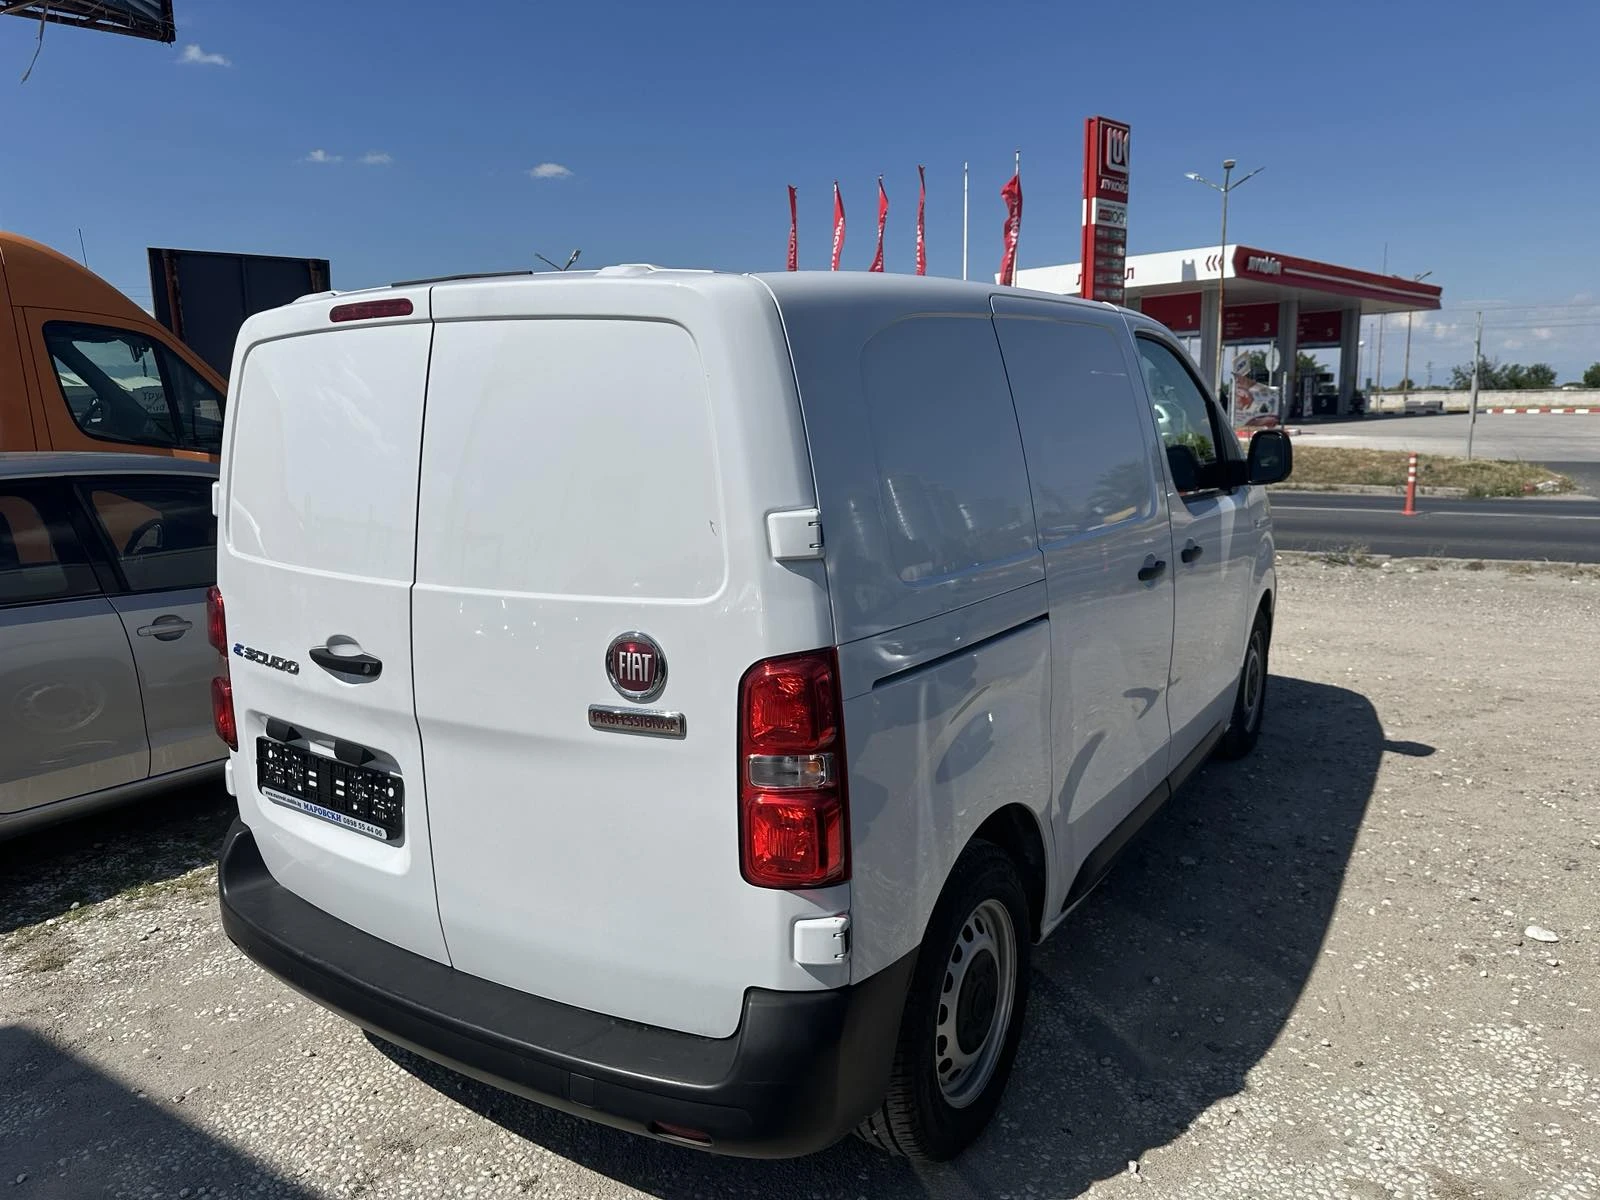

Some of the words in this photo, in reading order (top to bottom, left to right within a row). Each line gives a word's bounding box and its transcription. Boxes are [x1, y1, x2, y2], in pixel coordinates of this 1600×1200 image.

[619, 651, 652, 682] FIAT
[591, 711, 679, 730] PROFESSIONAL
[343, 817, 357, 827] 0898
[358, 822, 366, 831] 55
[366, 825, 374, 833] 44
